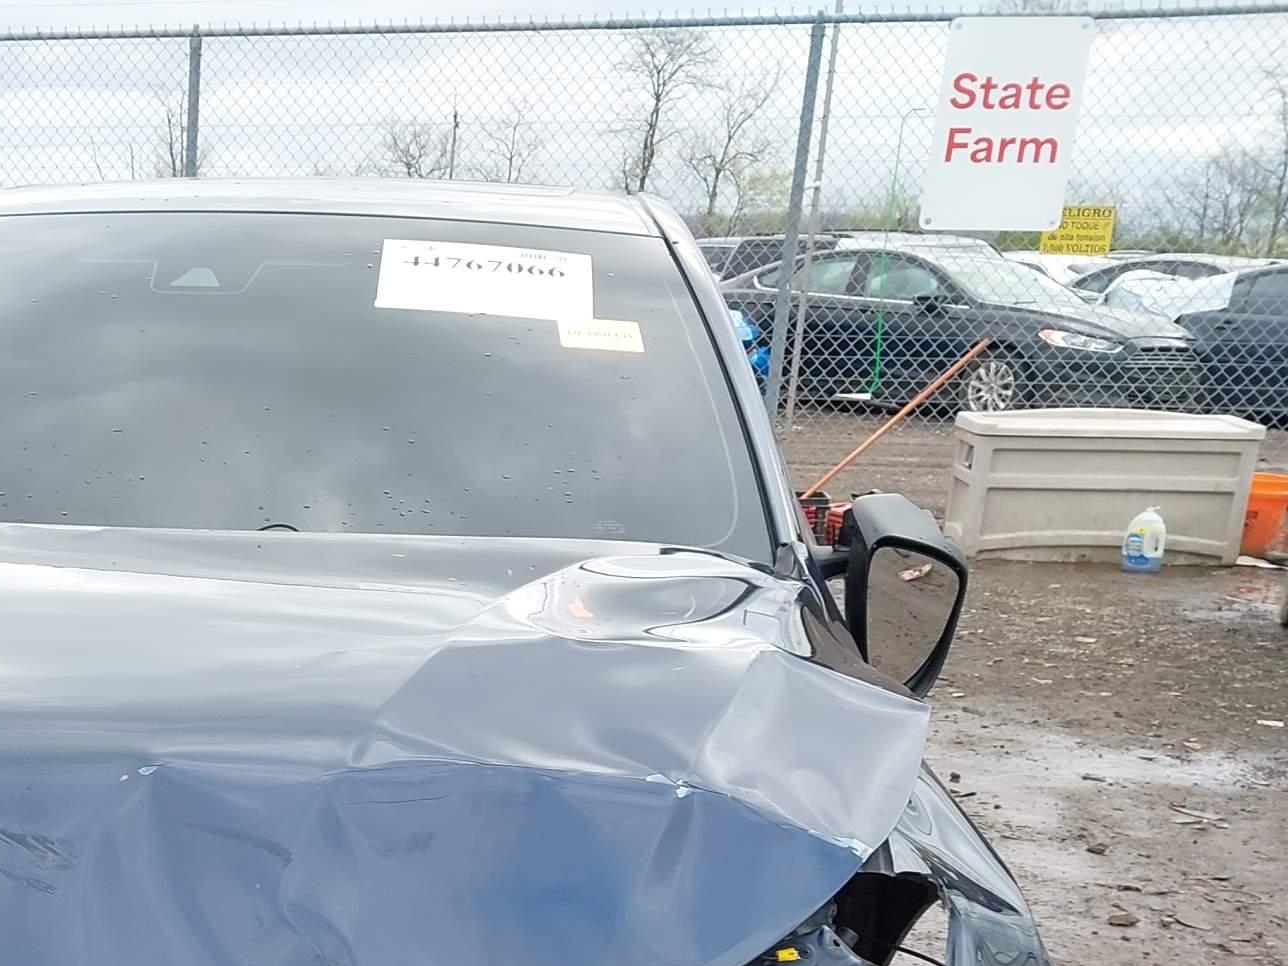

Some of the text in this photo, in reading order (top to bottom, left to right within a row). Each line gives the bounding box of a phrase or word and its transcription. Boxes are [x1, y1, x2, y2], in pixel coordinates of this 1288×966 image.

[949, 72, 1071, 110] State
[943, 127, 1058, 163] Farm
[1062, 207, 1112, 218] ELIGRO
[402, 255, 566, 278] 44767066
